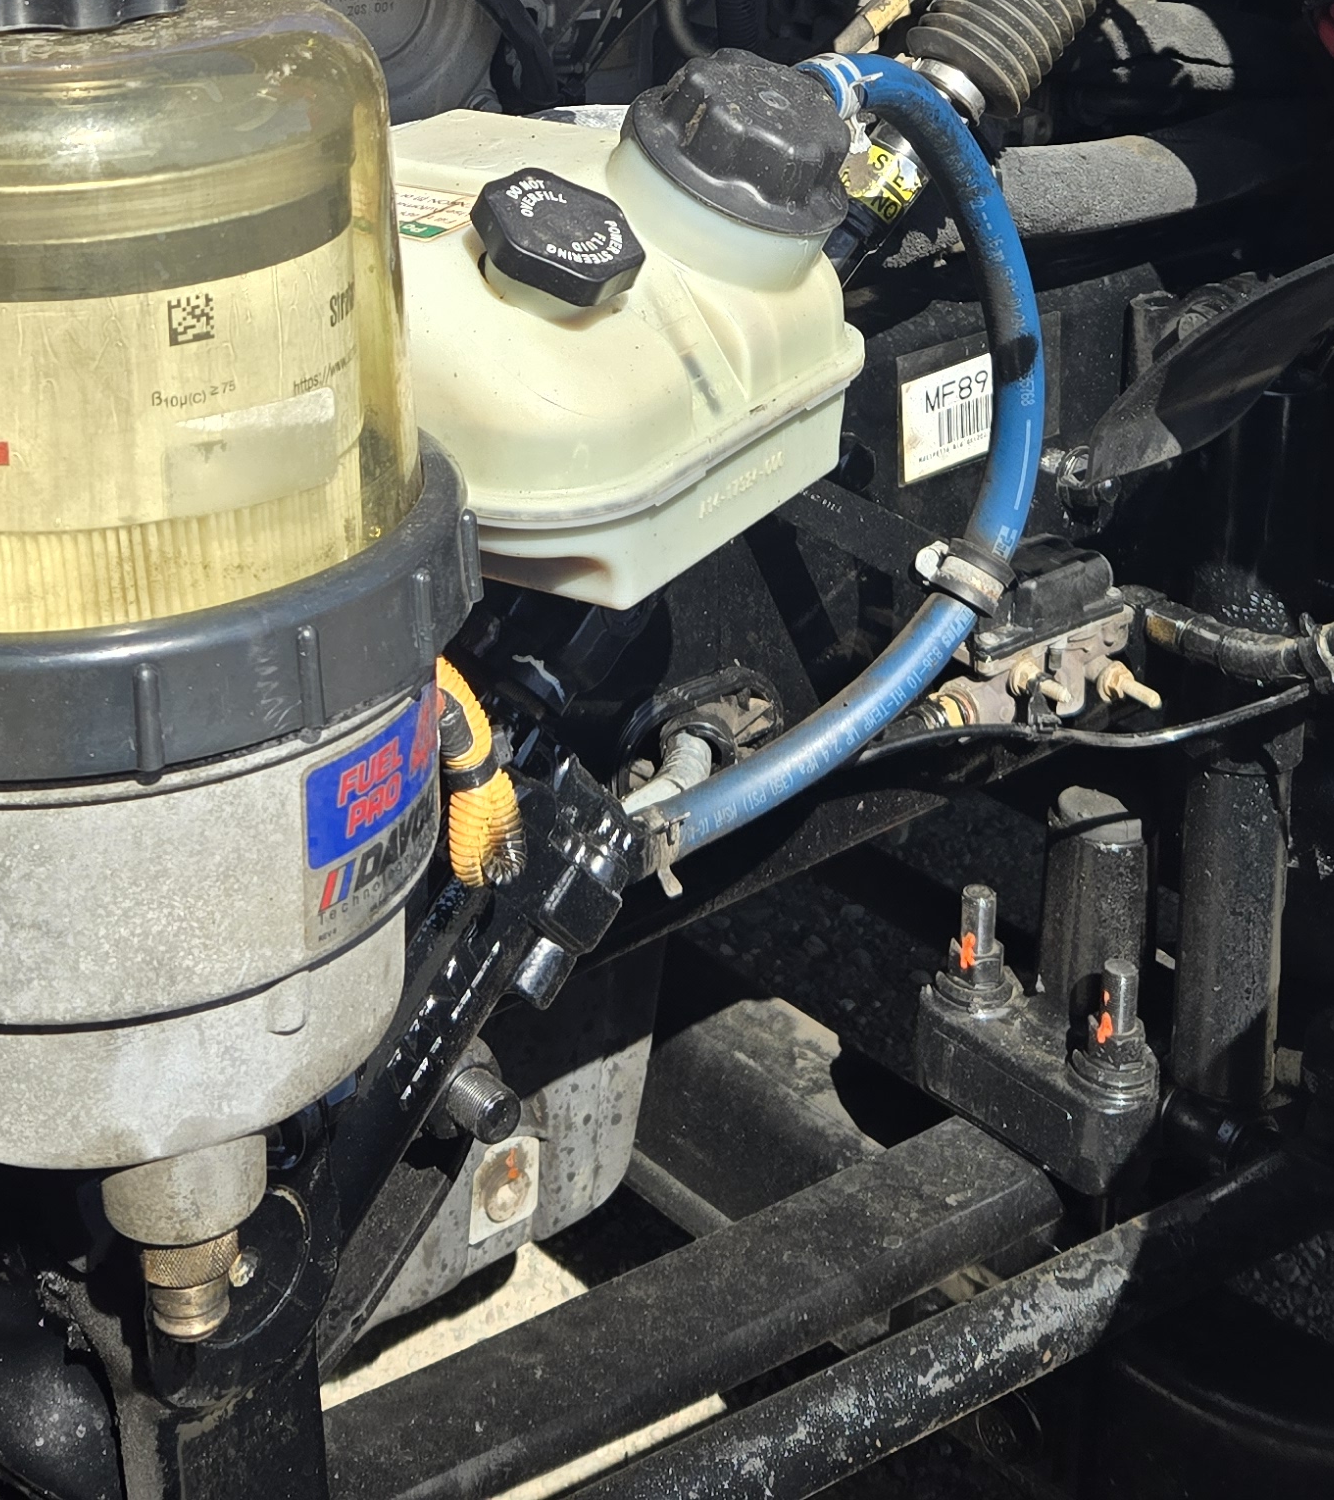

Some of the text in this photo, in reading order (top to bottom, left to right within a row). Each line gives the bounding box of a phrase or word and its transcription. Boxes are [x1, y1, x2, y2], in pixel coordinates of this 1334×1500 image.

[505, 179, 545, 200] DO NOT
[520, 190, 568, 218] OVERFILL
[545, 219, 624, 265] POWER STEERING
[571, 231, 607, 253] FLUID
[337, 736, 403, 808] FUEL
[345, 771, 402, 838] PRO
